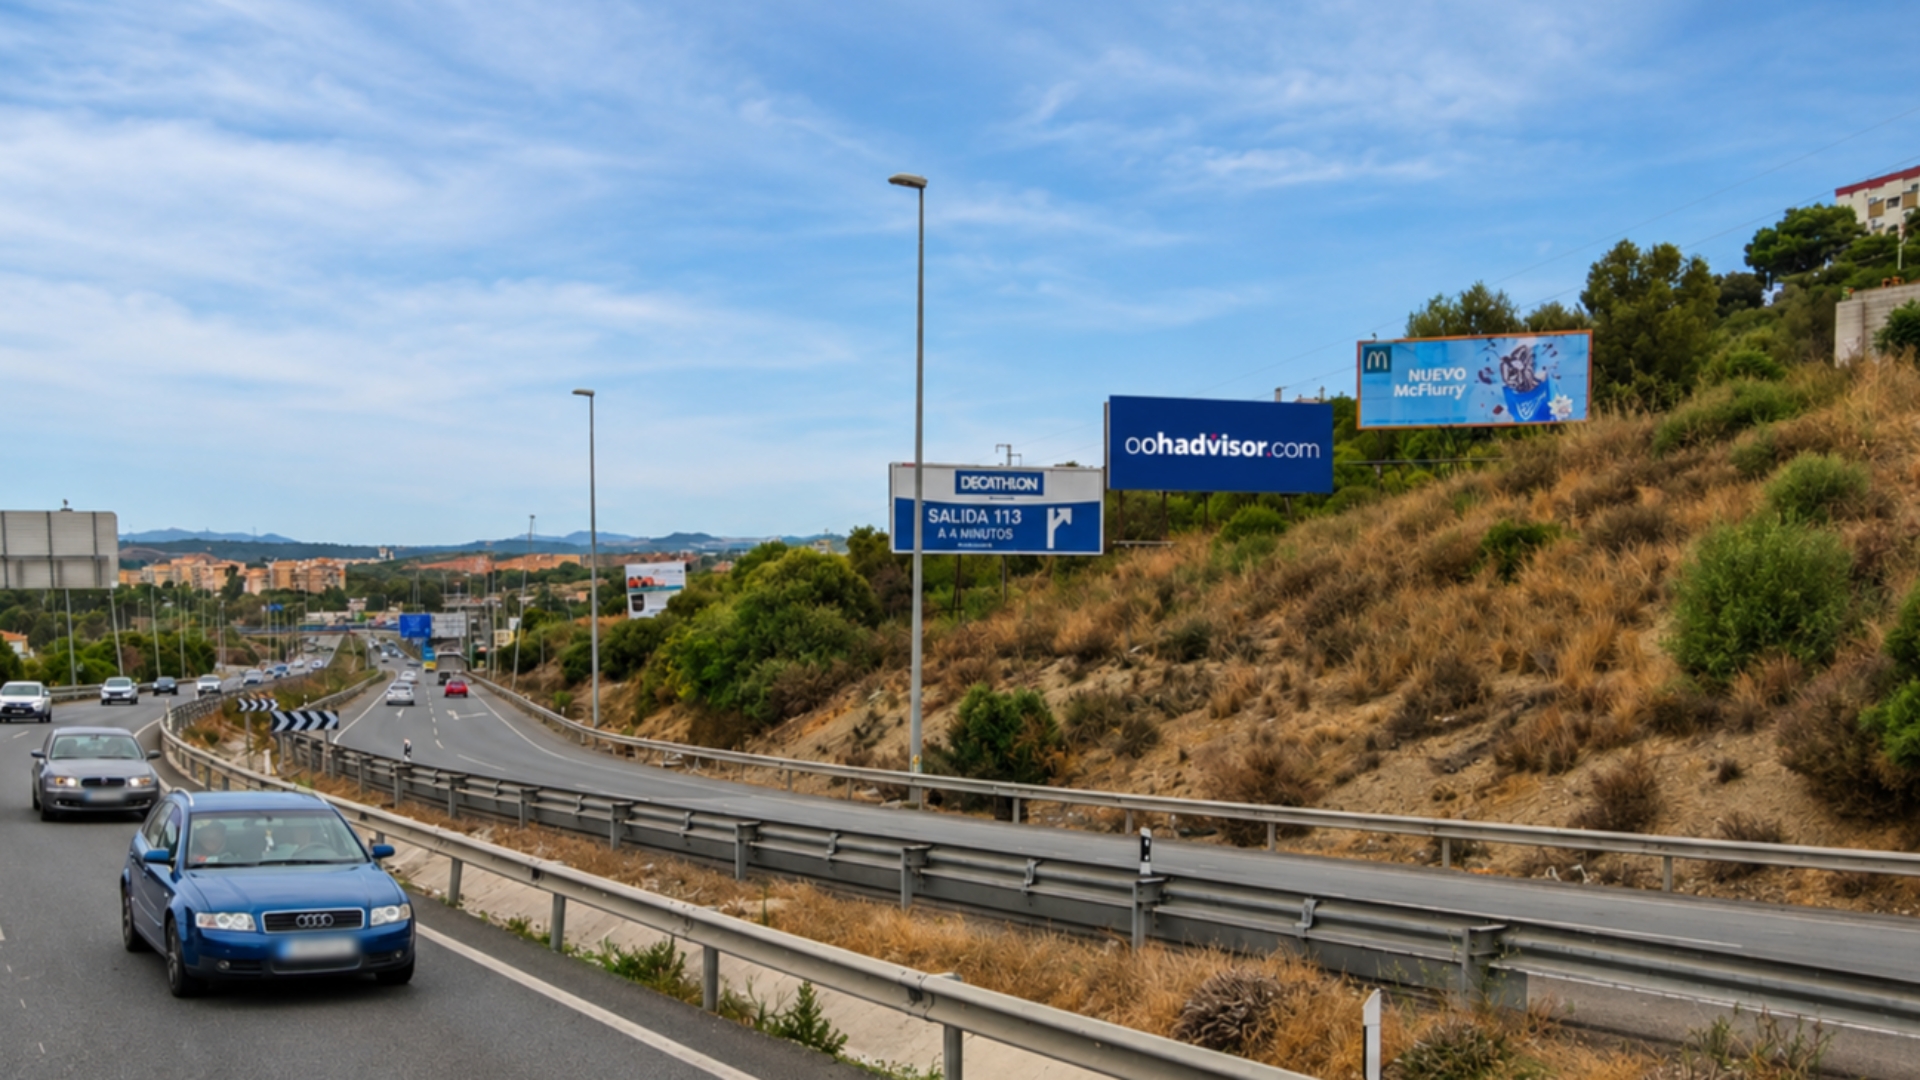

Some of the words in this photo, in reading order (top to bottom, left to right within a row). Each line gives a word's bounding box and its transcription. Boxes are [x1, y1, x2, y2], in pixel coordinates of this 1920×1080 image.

[1408, 367, 1467, 383] NUEVO
[1393, 384, 1467, 400] McFlurry
[1124, 431, 1320, 459] oohadvisor.com
[960, 475, 1038, 491] DECATHLON
[928, 508, 990, 525] SALIDA
[994, 508, 1022, 525] 113
[937, 527, 947, 539] A
[960, 527, 1014, 540] MINUTOS
